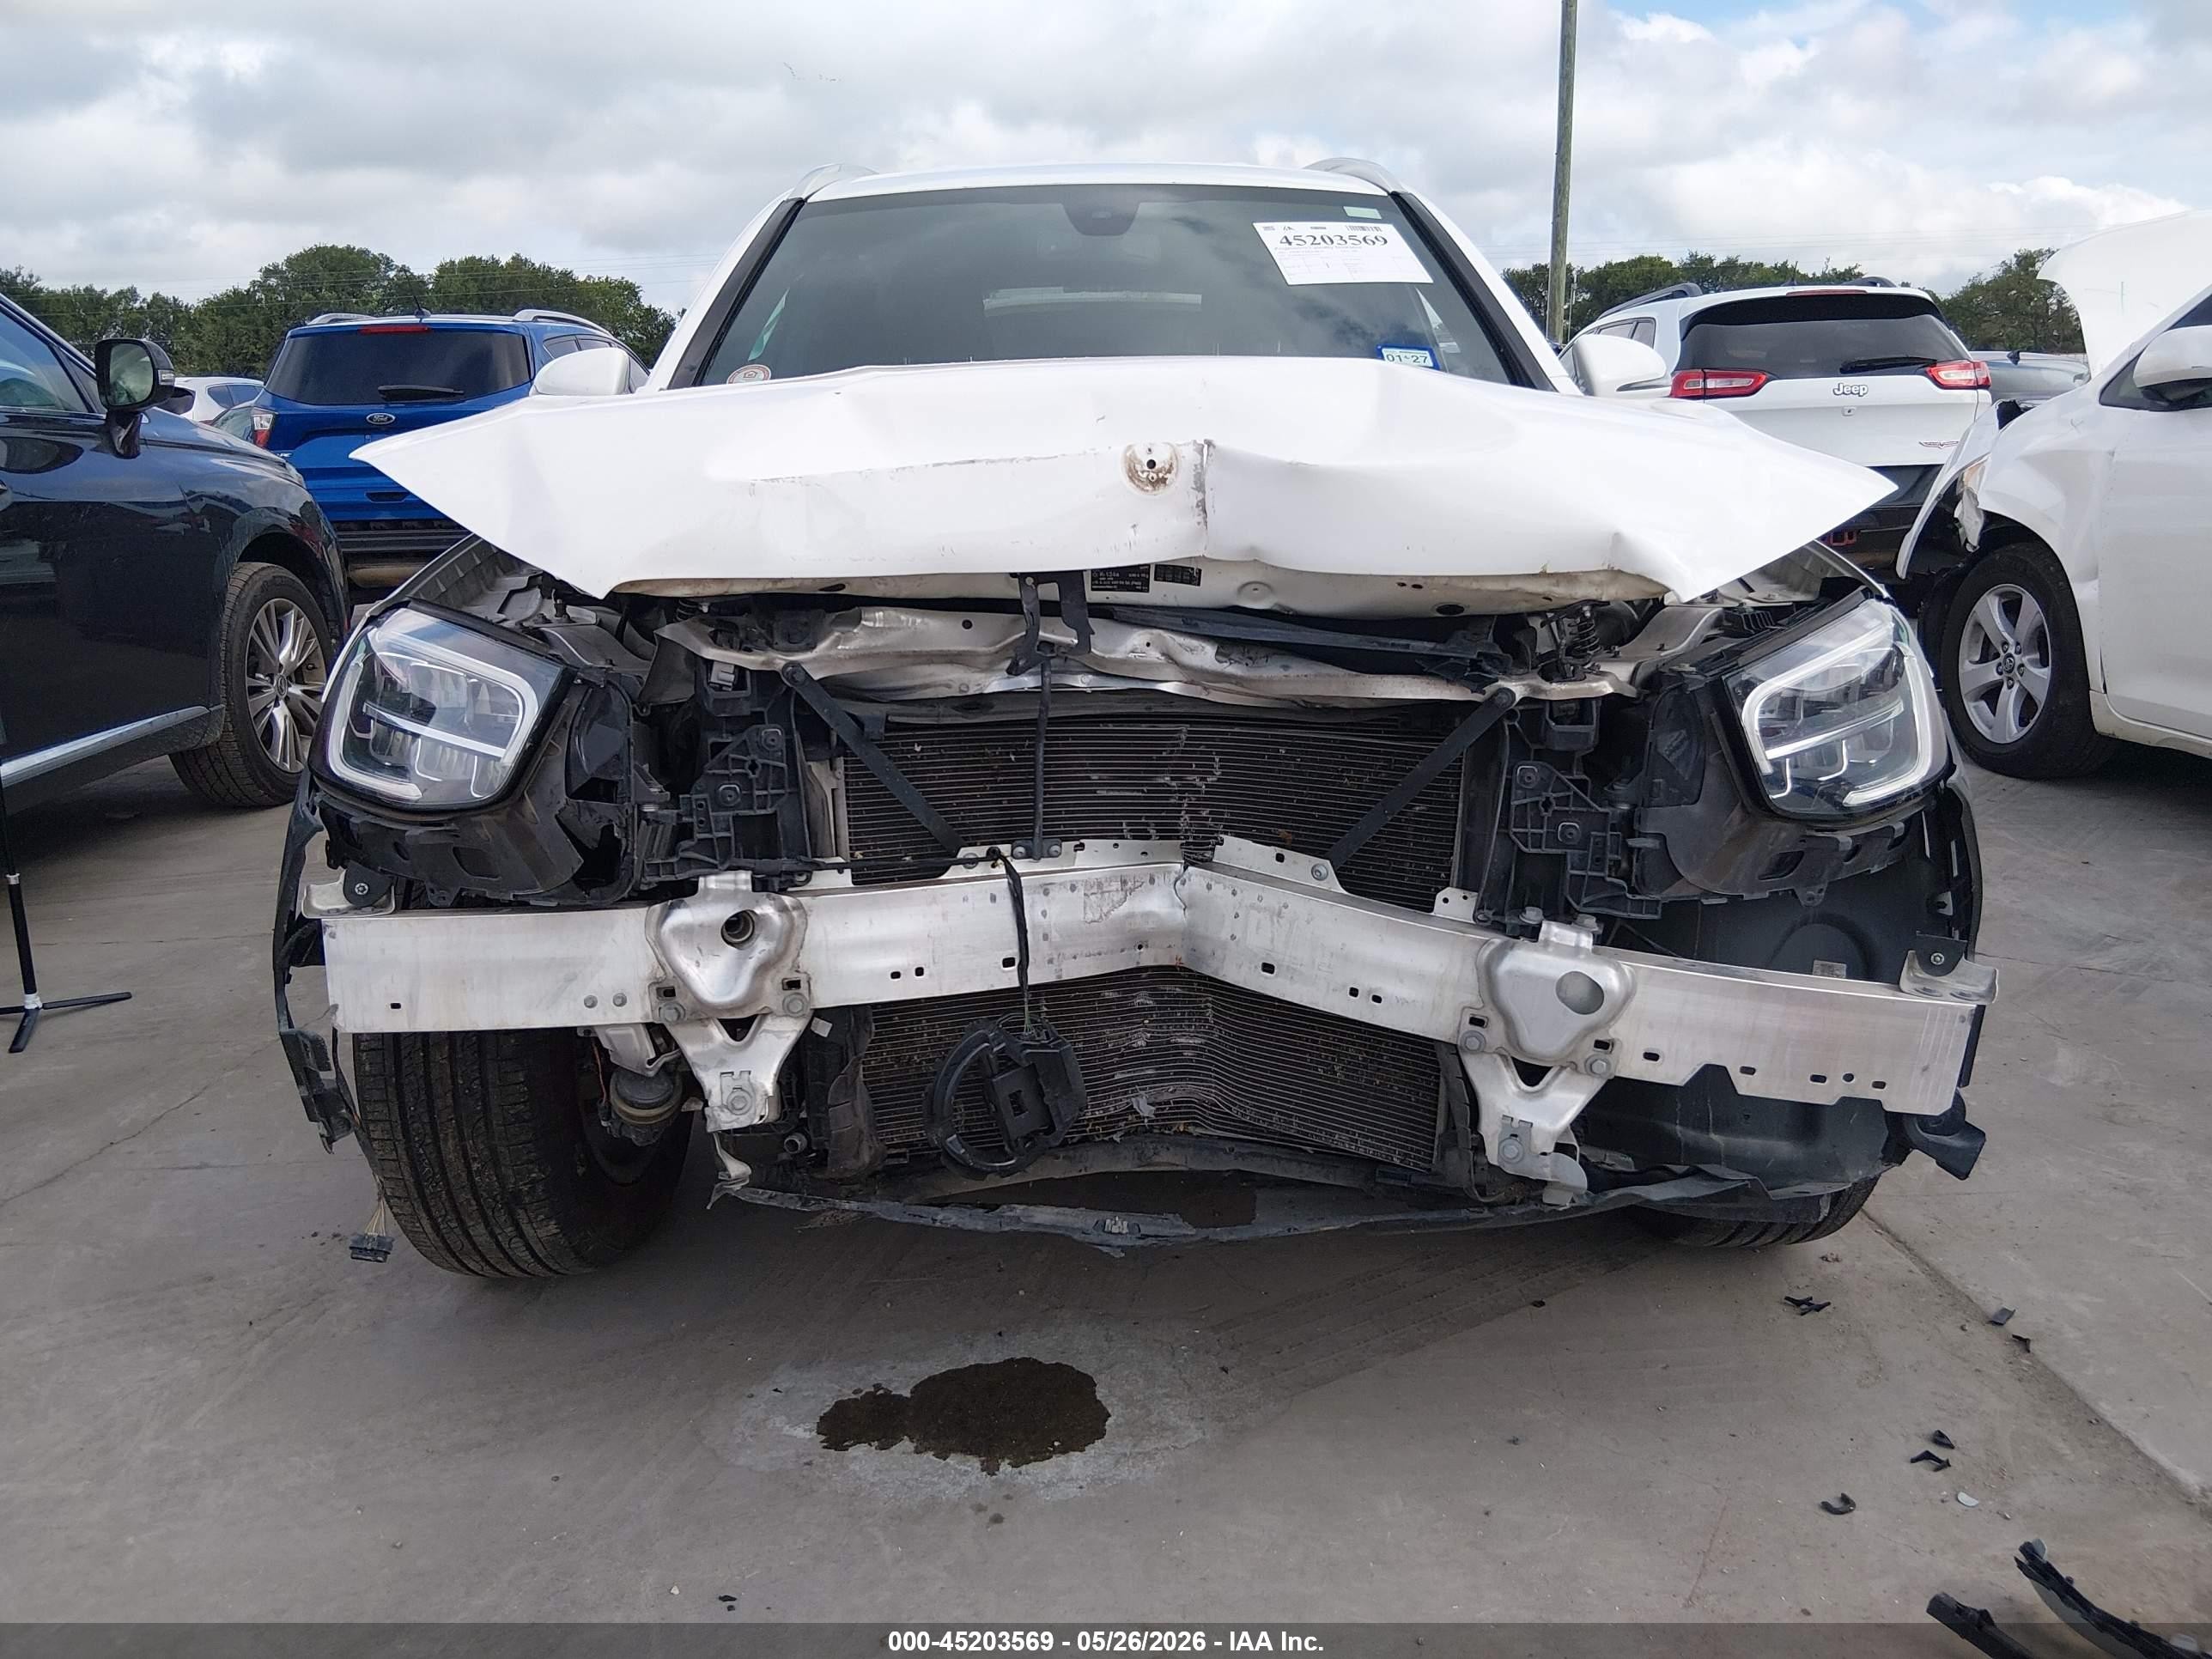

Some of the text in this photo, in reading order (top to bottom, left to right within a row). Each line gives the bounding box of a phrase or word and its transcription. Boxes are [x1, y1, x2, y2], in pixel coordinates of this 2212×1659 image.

[1279, 234, 1389, 246] 45203569
[1386, 354, 1428, 364] 01 27
[1832, 382, 1869, 398] Jeep
